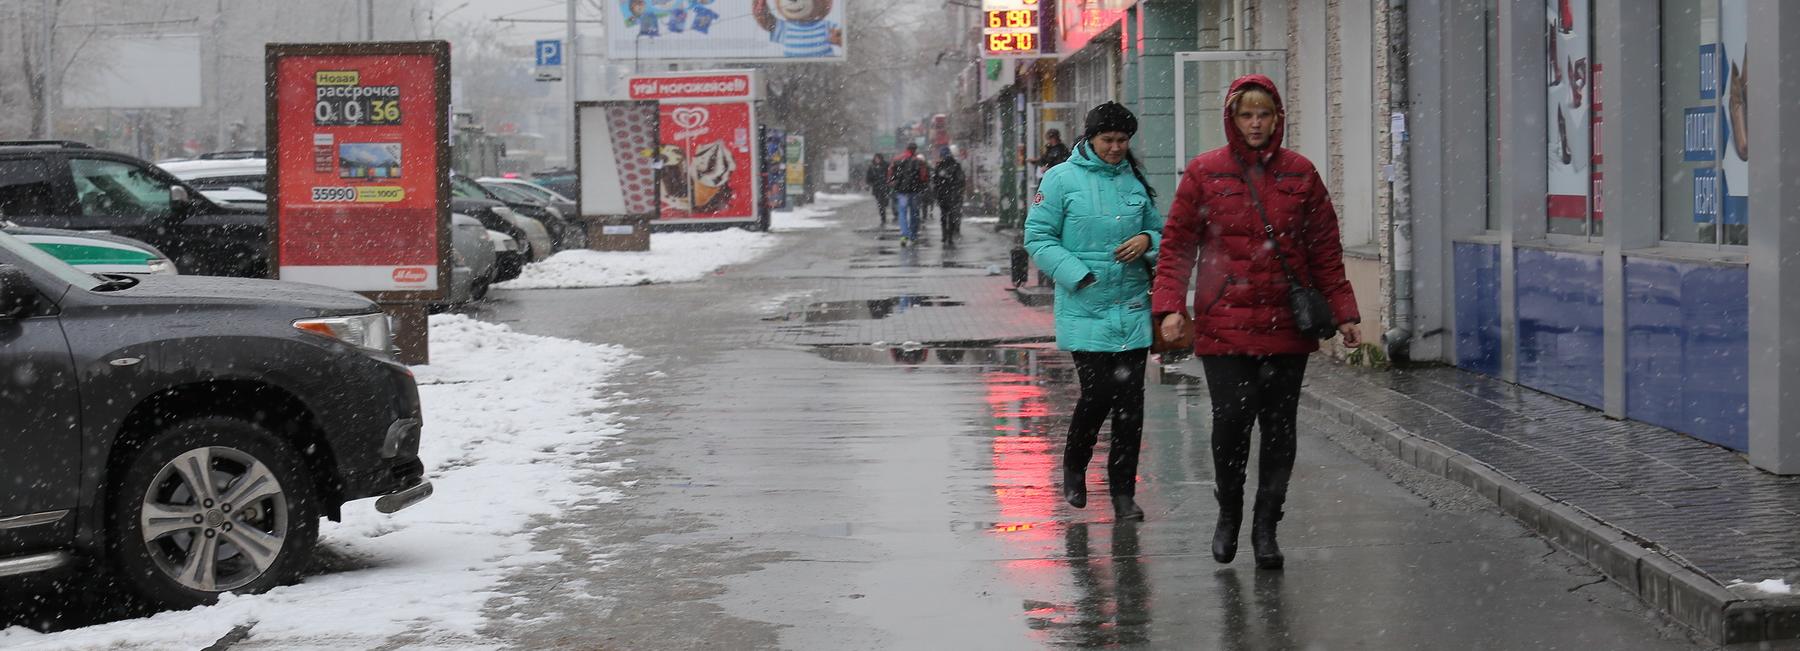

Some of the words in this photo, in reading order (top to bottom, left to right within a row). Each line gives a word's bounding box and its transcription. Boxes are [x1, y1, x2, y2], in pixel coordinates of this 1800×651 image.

[541, 43, 557, 64] P
[320, 73, 356, 84] Новая
[316, 86, 399, 101] рассрочка
[370, 101, 400, 121] 36
[313, 188, 355, 201] 35990
